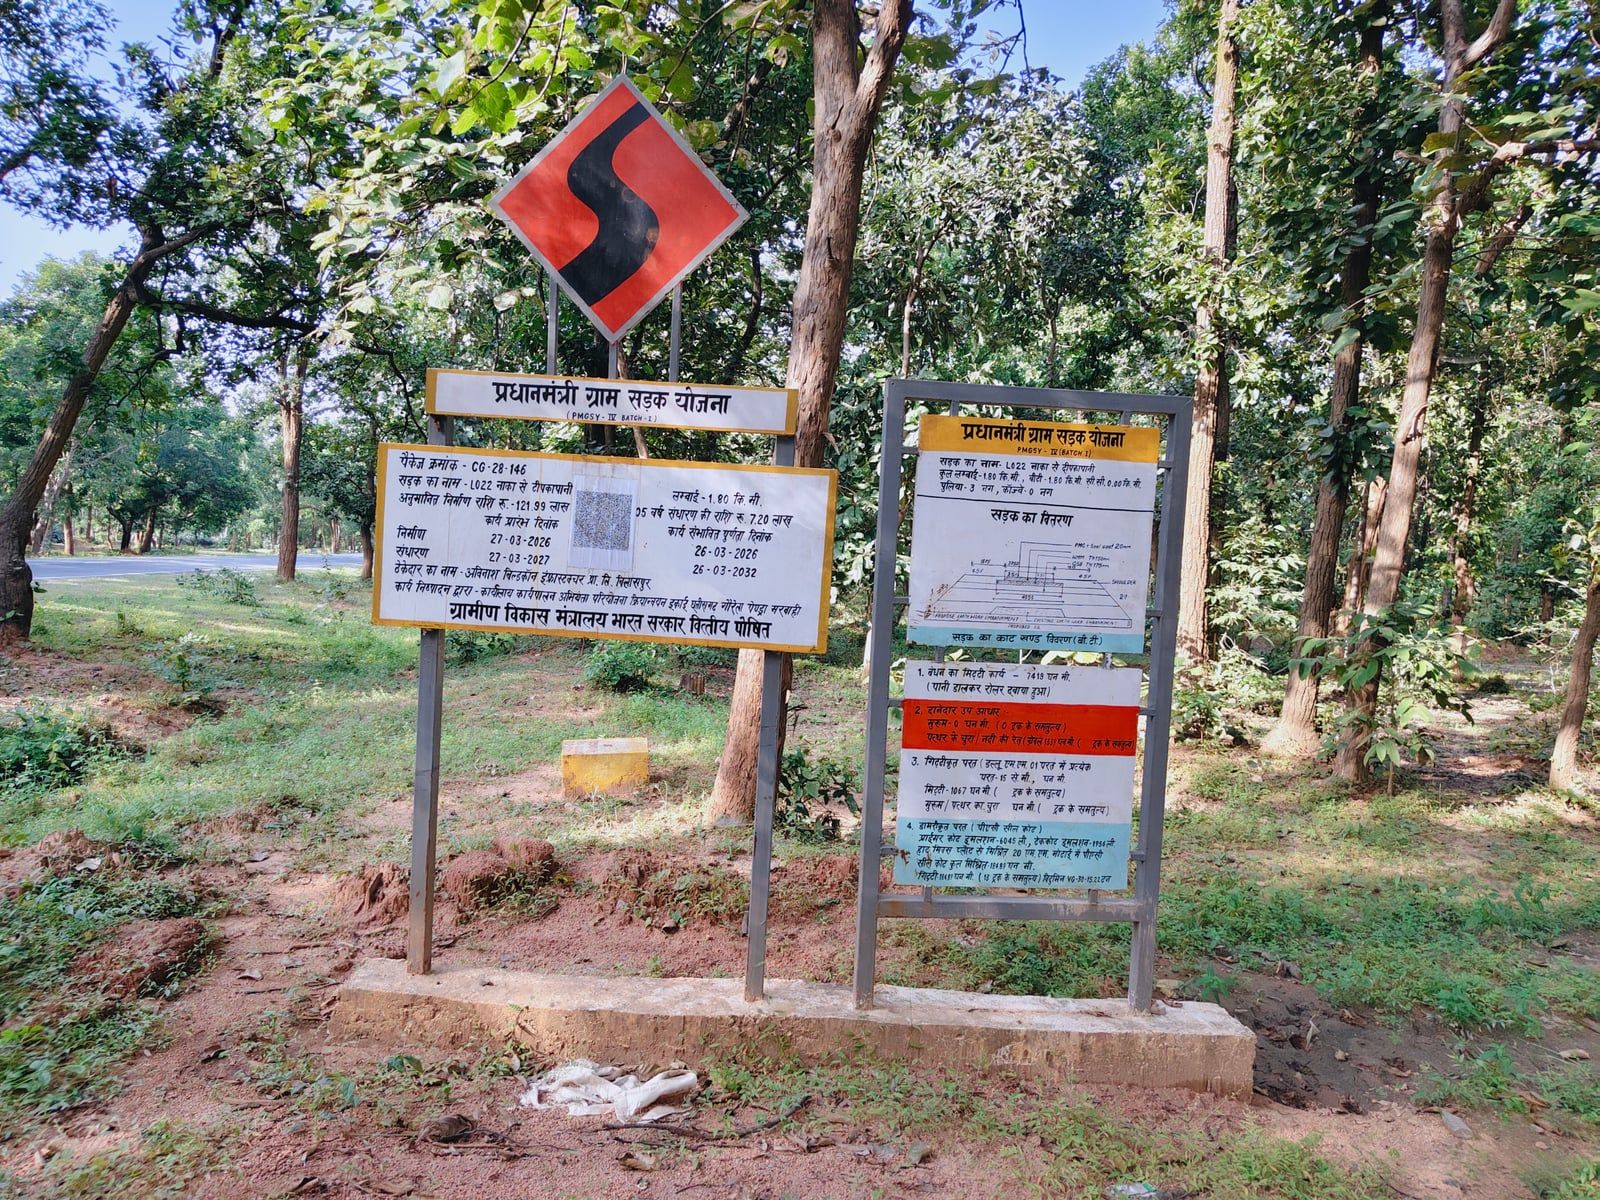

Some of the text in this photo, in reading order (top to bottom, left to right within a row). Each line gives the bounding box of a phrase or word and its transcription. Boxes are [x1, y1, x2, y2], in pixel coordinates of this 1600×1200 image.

[493, 380, 732, 414] प्रधानमंत्री ग्राम सड़क योजना
[961, 423, 1125, 448] प्रधानमंत्री ग्राम सड़क योजना
[426, 476, 439, 486] का
[520, 480, 528, 494] से
[399, 492, 495, 512] अनुमानित निर्माण राशि
[485, 515, 500, 525] कार्य
[535, 517, 559, 530] दिनांक
[668, 506, 698, 521] संधारण
[700, 508, 709, 520] की
[715, 509, 733, 524] राशि
[991, 508, 1020, 525] सड़क
[1022, 511, 1036, 523] का
[397, 525, 426, 540] निर्माण
[668, 525, 685, 537] कार्य
[748, 529, 773, 543] दिनांक
[426, 565, 437, 575] का
[441, 566, 458, 576] नाम
[395, 580, 412, 592] कार्य
[450, 599, 500, 622] ग्रामीण
[505, 603, 550, 629] विकास
[556, 605, 609, 628] मंत्रालय
[612, 613, 644, 631] भारत
[647, 615, 685, 635] सरकार
[734, 616, 772, 639] पोषित
[948, 668, 959, 677] का
